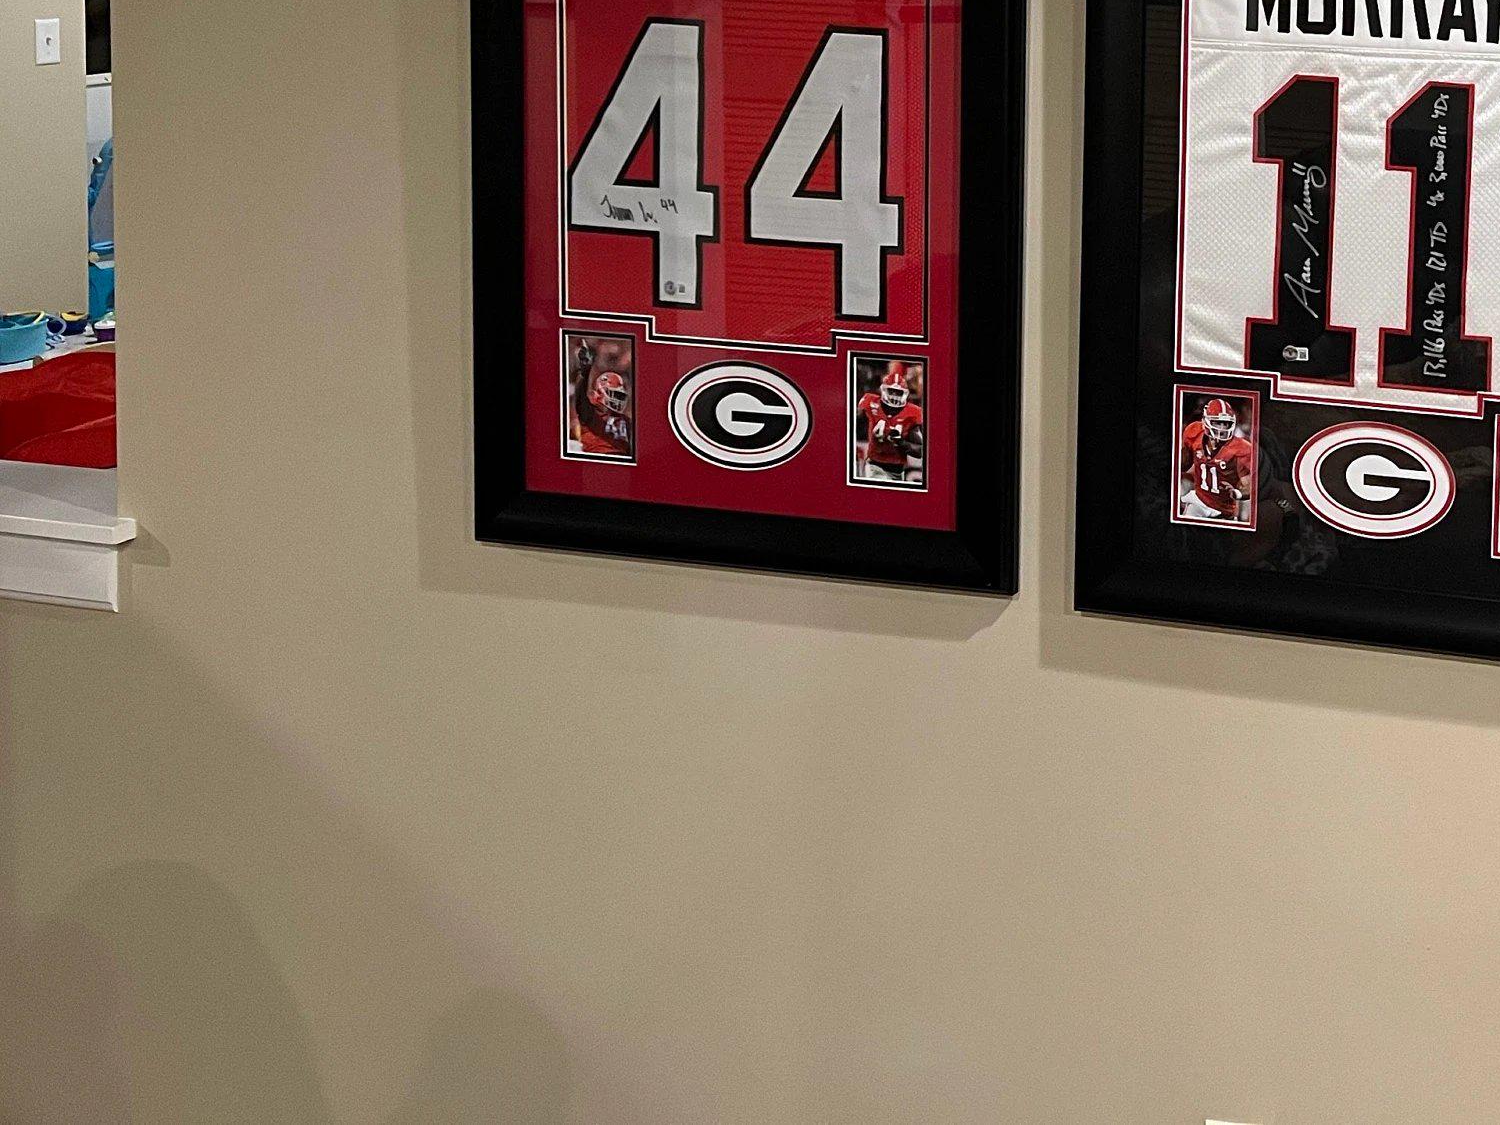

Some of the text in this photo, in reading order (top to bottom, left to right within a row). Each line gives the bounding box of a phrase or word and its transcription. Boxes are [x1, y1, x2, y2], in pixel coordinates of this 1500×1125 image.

[566, 16, 904, 323] 44
[1243, 74, 1492, 395] 11
[690, 379, 794, 451] G
[1200, 462, 1220, 494] 11
[1319, 441, 1433, 516] G
